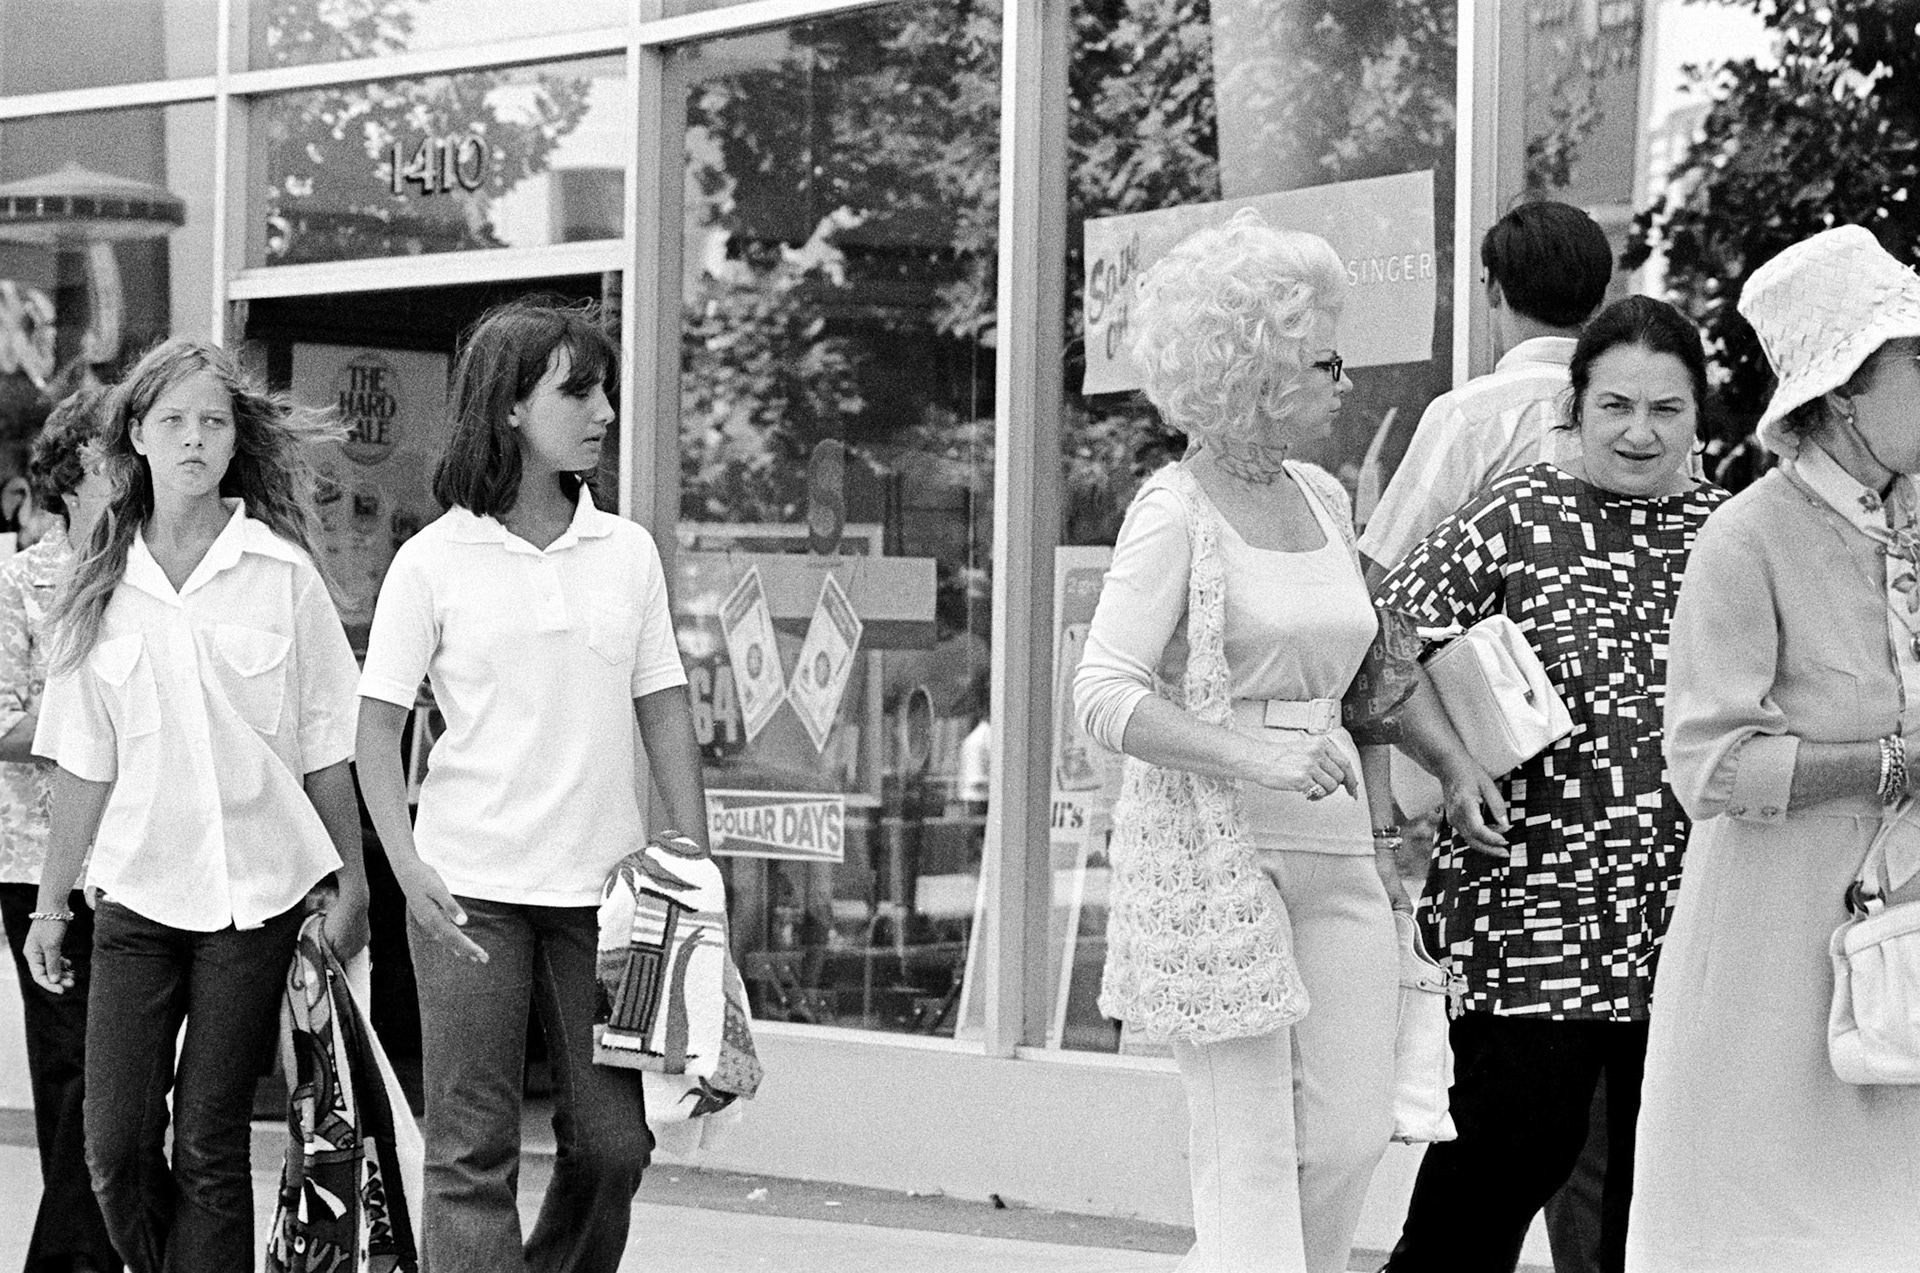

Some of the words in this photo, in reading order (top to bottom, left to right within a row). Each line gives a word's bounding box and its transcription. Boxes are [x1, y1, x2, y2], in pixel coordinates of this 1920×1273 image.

[391, 134, 489, 196] 1410
[1346, 252, 1433, 287] SINGER
[347, 365, 388, 392] THE
[339, 390, 397, 418] HARD
[713, 808, 776, 843] DOLLAR
[782, 804, 841, 852] DAYS
